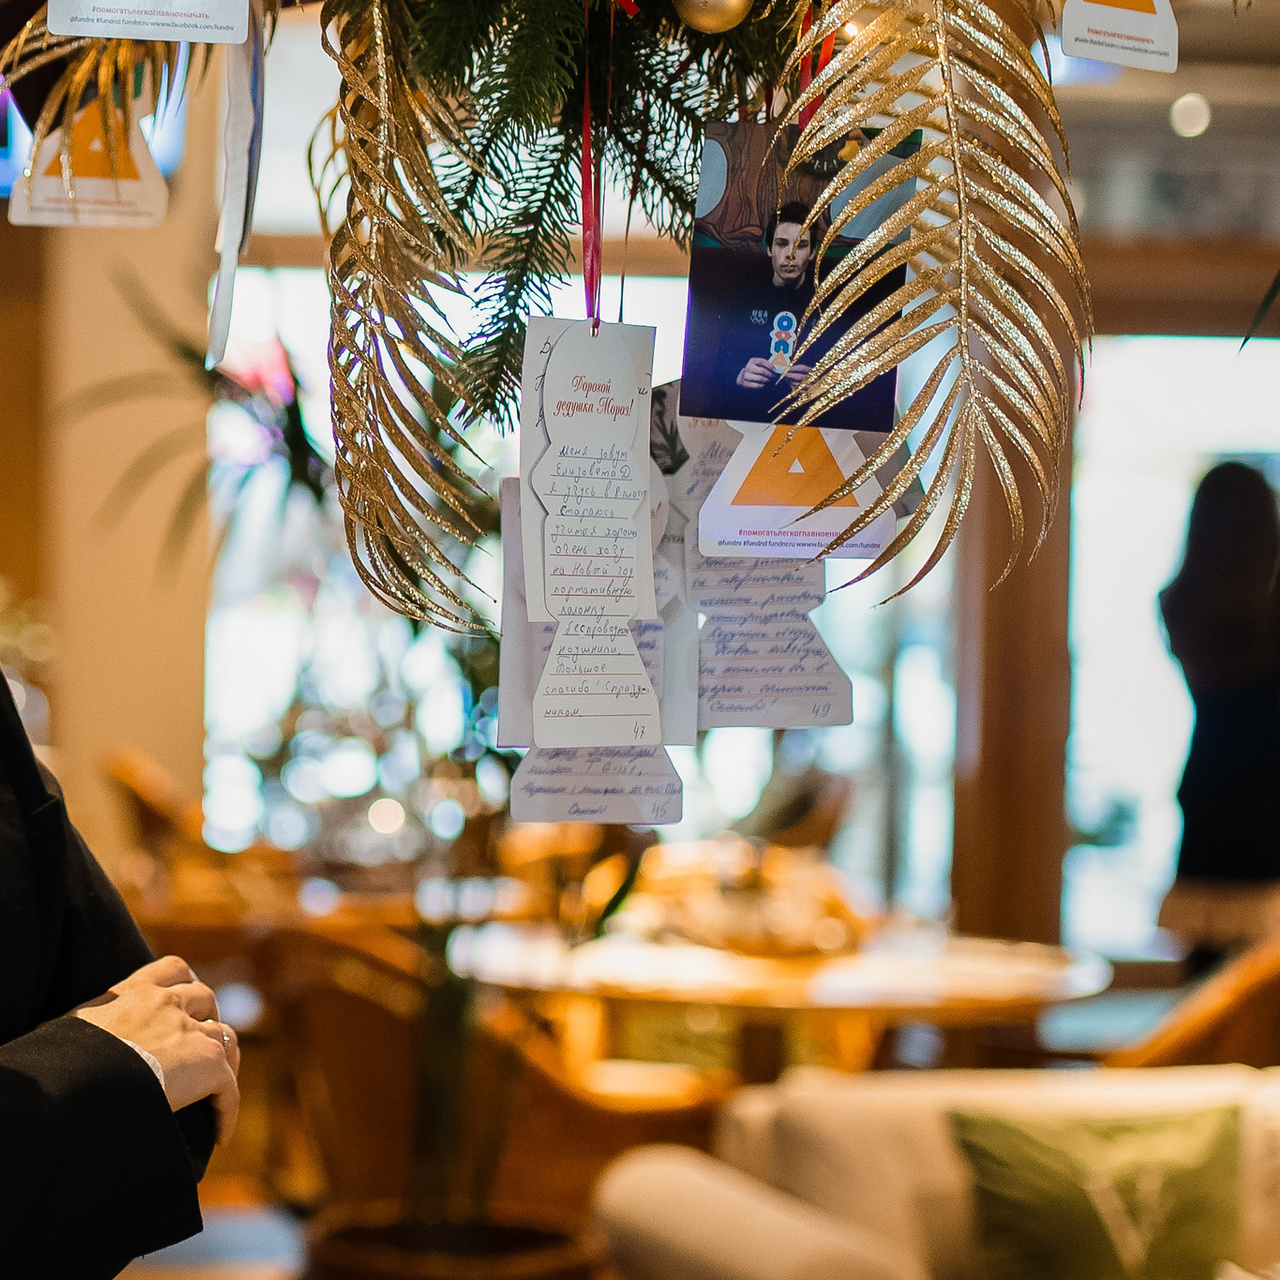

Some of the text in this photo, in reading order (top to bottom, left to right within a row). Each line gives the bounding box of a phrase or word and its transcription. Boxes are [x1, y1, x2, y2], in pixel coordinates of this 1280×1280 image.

[752, 309, 768, 318] USA
[571, 375, 611, 398] Дорогой
[553, 400, 594, 417] дедушка
[596, 396, 634, 421] Мороз!
[738, 528, 841, 538] #помогатьлегкоглавноена
[555, 543, 624, 564] очень хочу
[553, 565, 565, 576] на
[632, 721, 646, 740] 47
